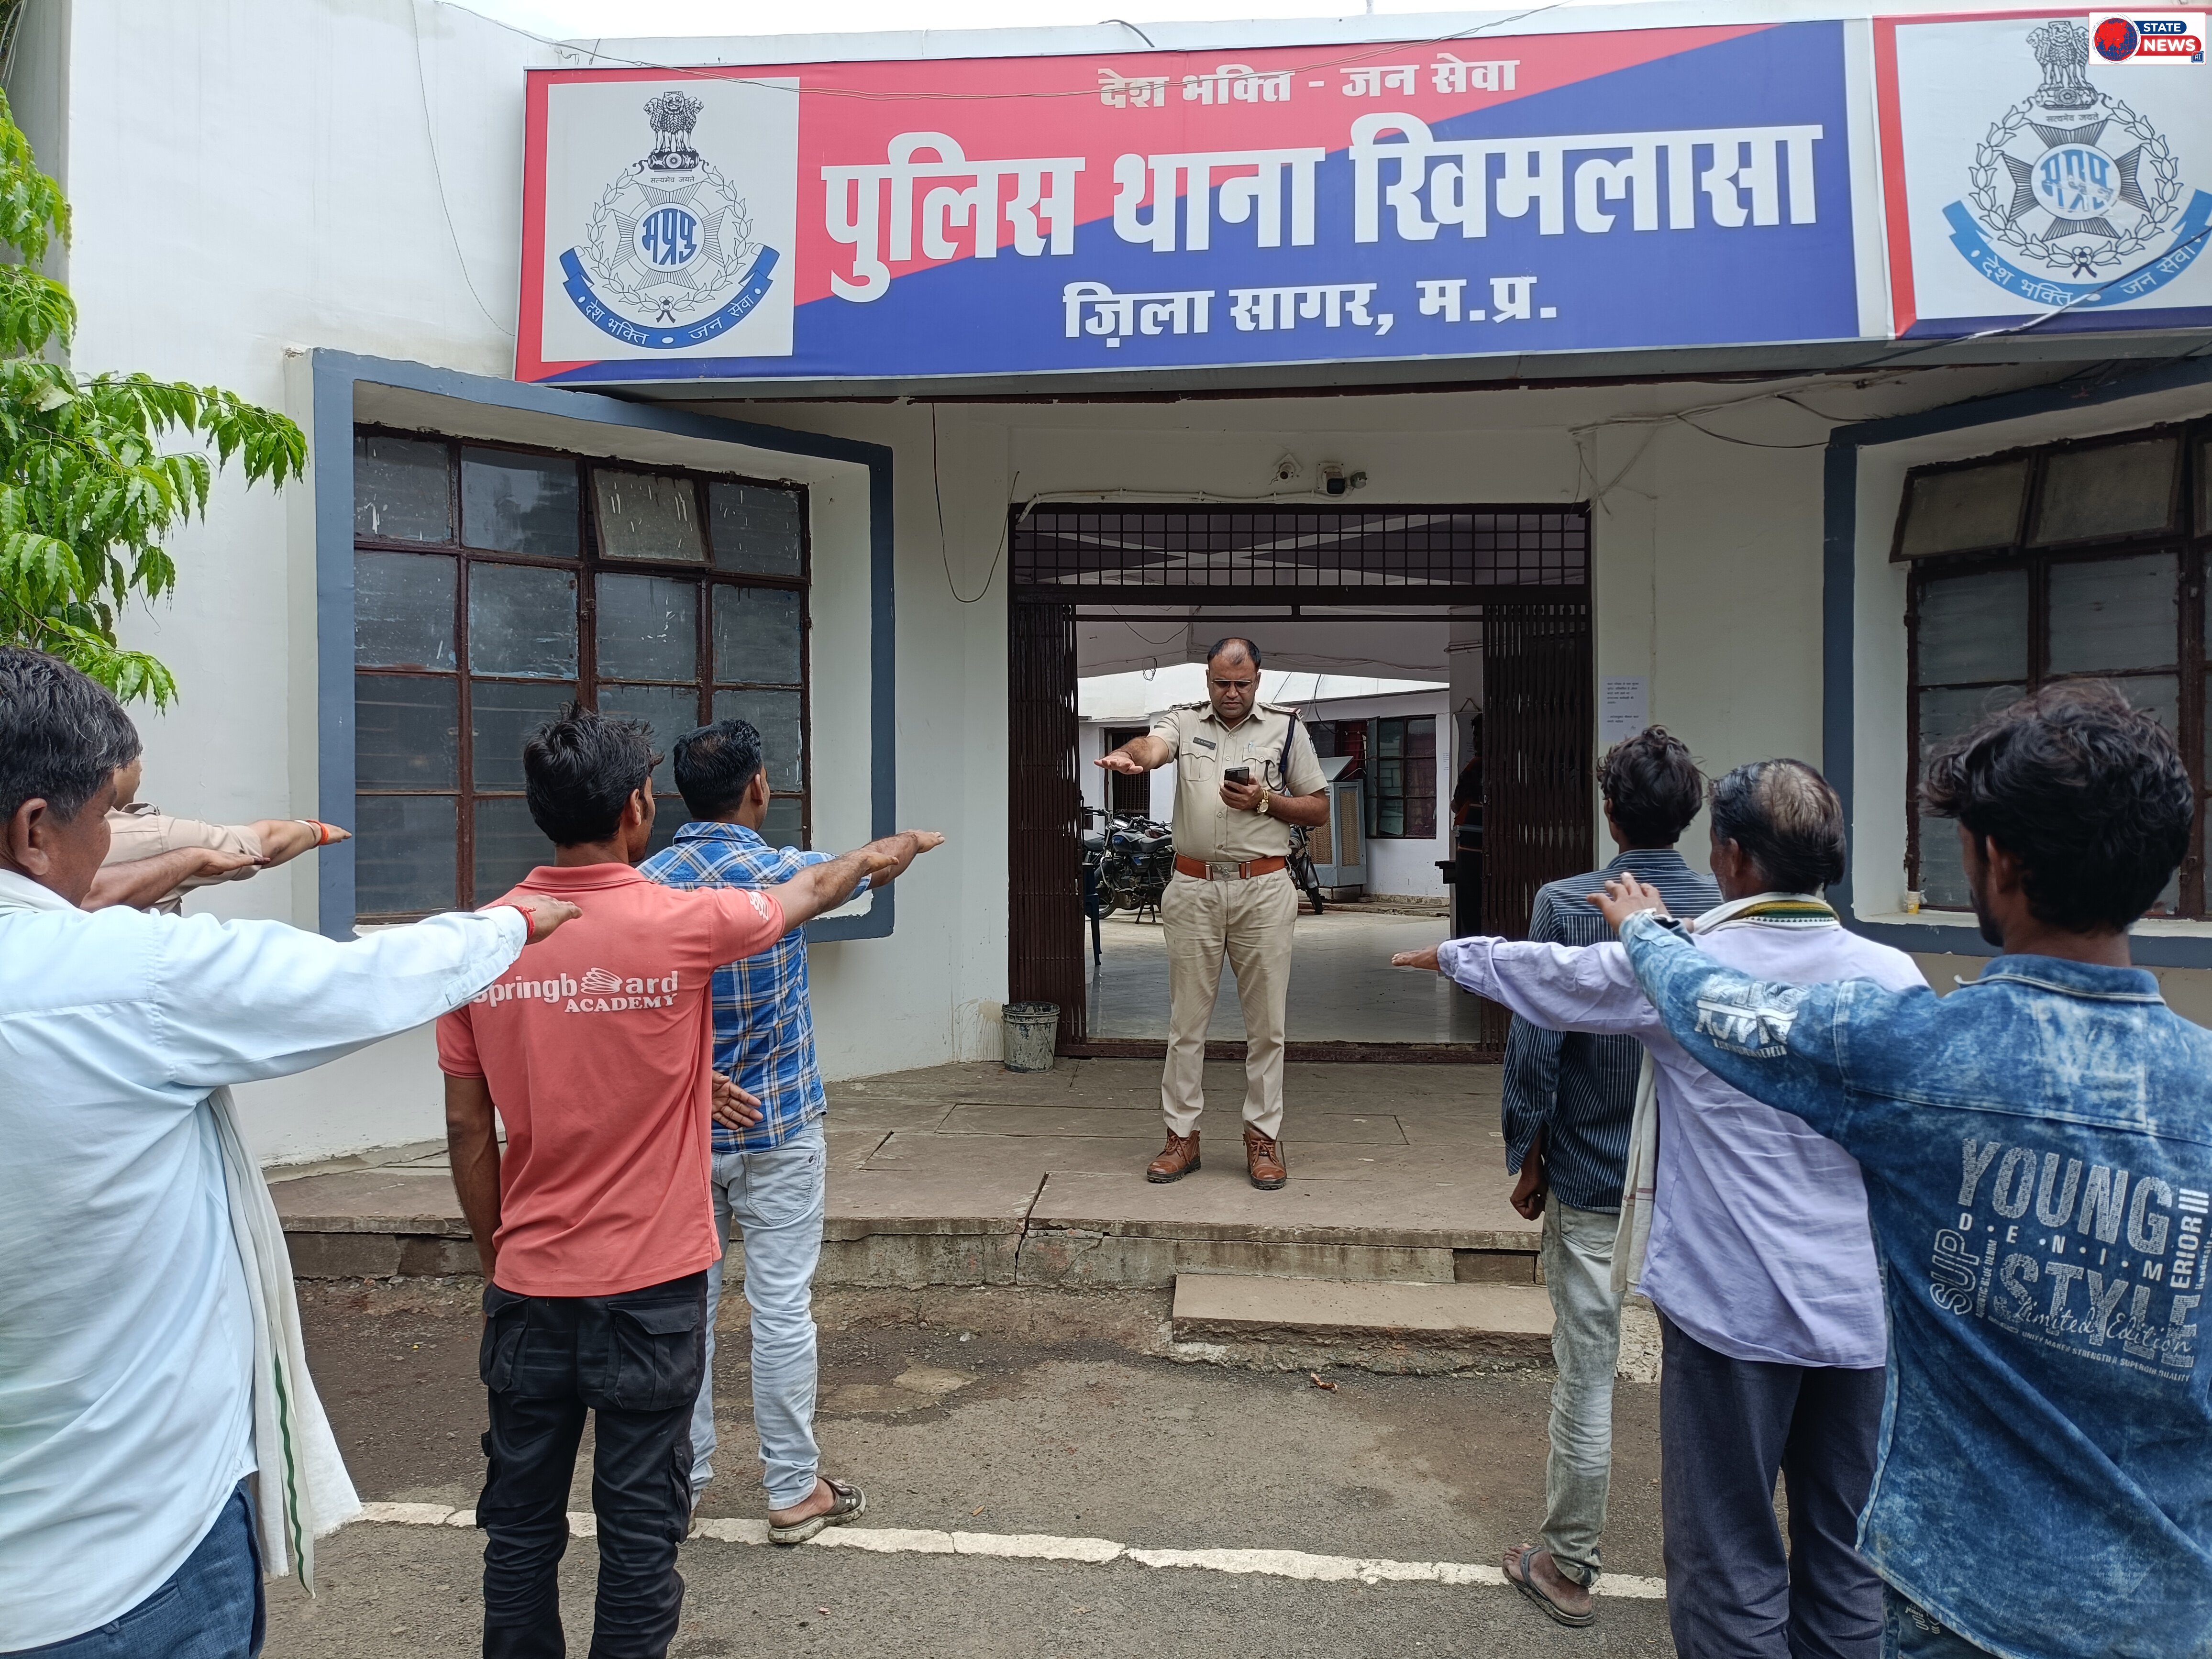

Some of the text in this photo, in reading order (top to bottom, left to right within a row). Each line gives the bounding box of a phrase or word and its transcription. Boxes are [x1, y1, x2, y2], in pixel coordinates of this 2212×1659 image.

[1098, 67, 1169, 109] देश
[1183, 64, 1295, 105] भक्ति
[1340, 64, 1416, 97] जन
[1431, 52, 1521, 94] सेवा
[650, 175, 675, 184] सत्यमेव
[821, 112, 1823, 303] पुलिस थाना खिमलासा
[1982, 245, 2197, 305] देश भक्ति जन सेवा
[585, 294, 755, 345] देश भक्ति जन सेवा
[1228, 283, 1394, 335] सागर,
[1416, 276, 1557, 323] म.प्र.
[564, 993, 678, 1013] ACADEMY
[1958, 1138, 2173, 1256] YOUNG
[1929, 1228, 1980, 1315] SUP
[1980, 1266, 1993, 1287] BLUE
[1983, 1239, 1998, 1266] DENIM
[2169, 1216, 2202, 1289] ERIOR
[1992, 1252, 2201, 1369] STYLE
[2013, 1296, 2095, 1334] Limited
[2106, 1312, 2193, 1353] Edition
[2022, 1330, 2045, 1342] UNITY
[2072, 1348, 2112, 1363] STRENGTH
